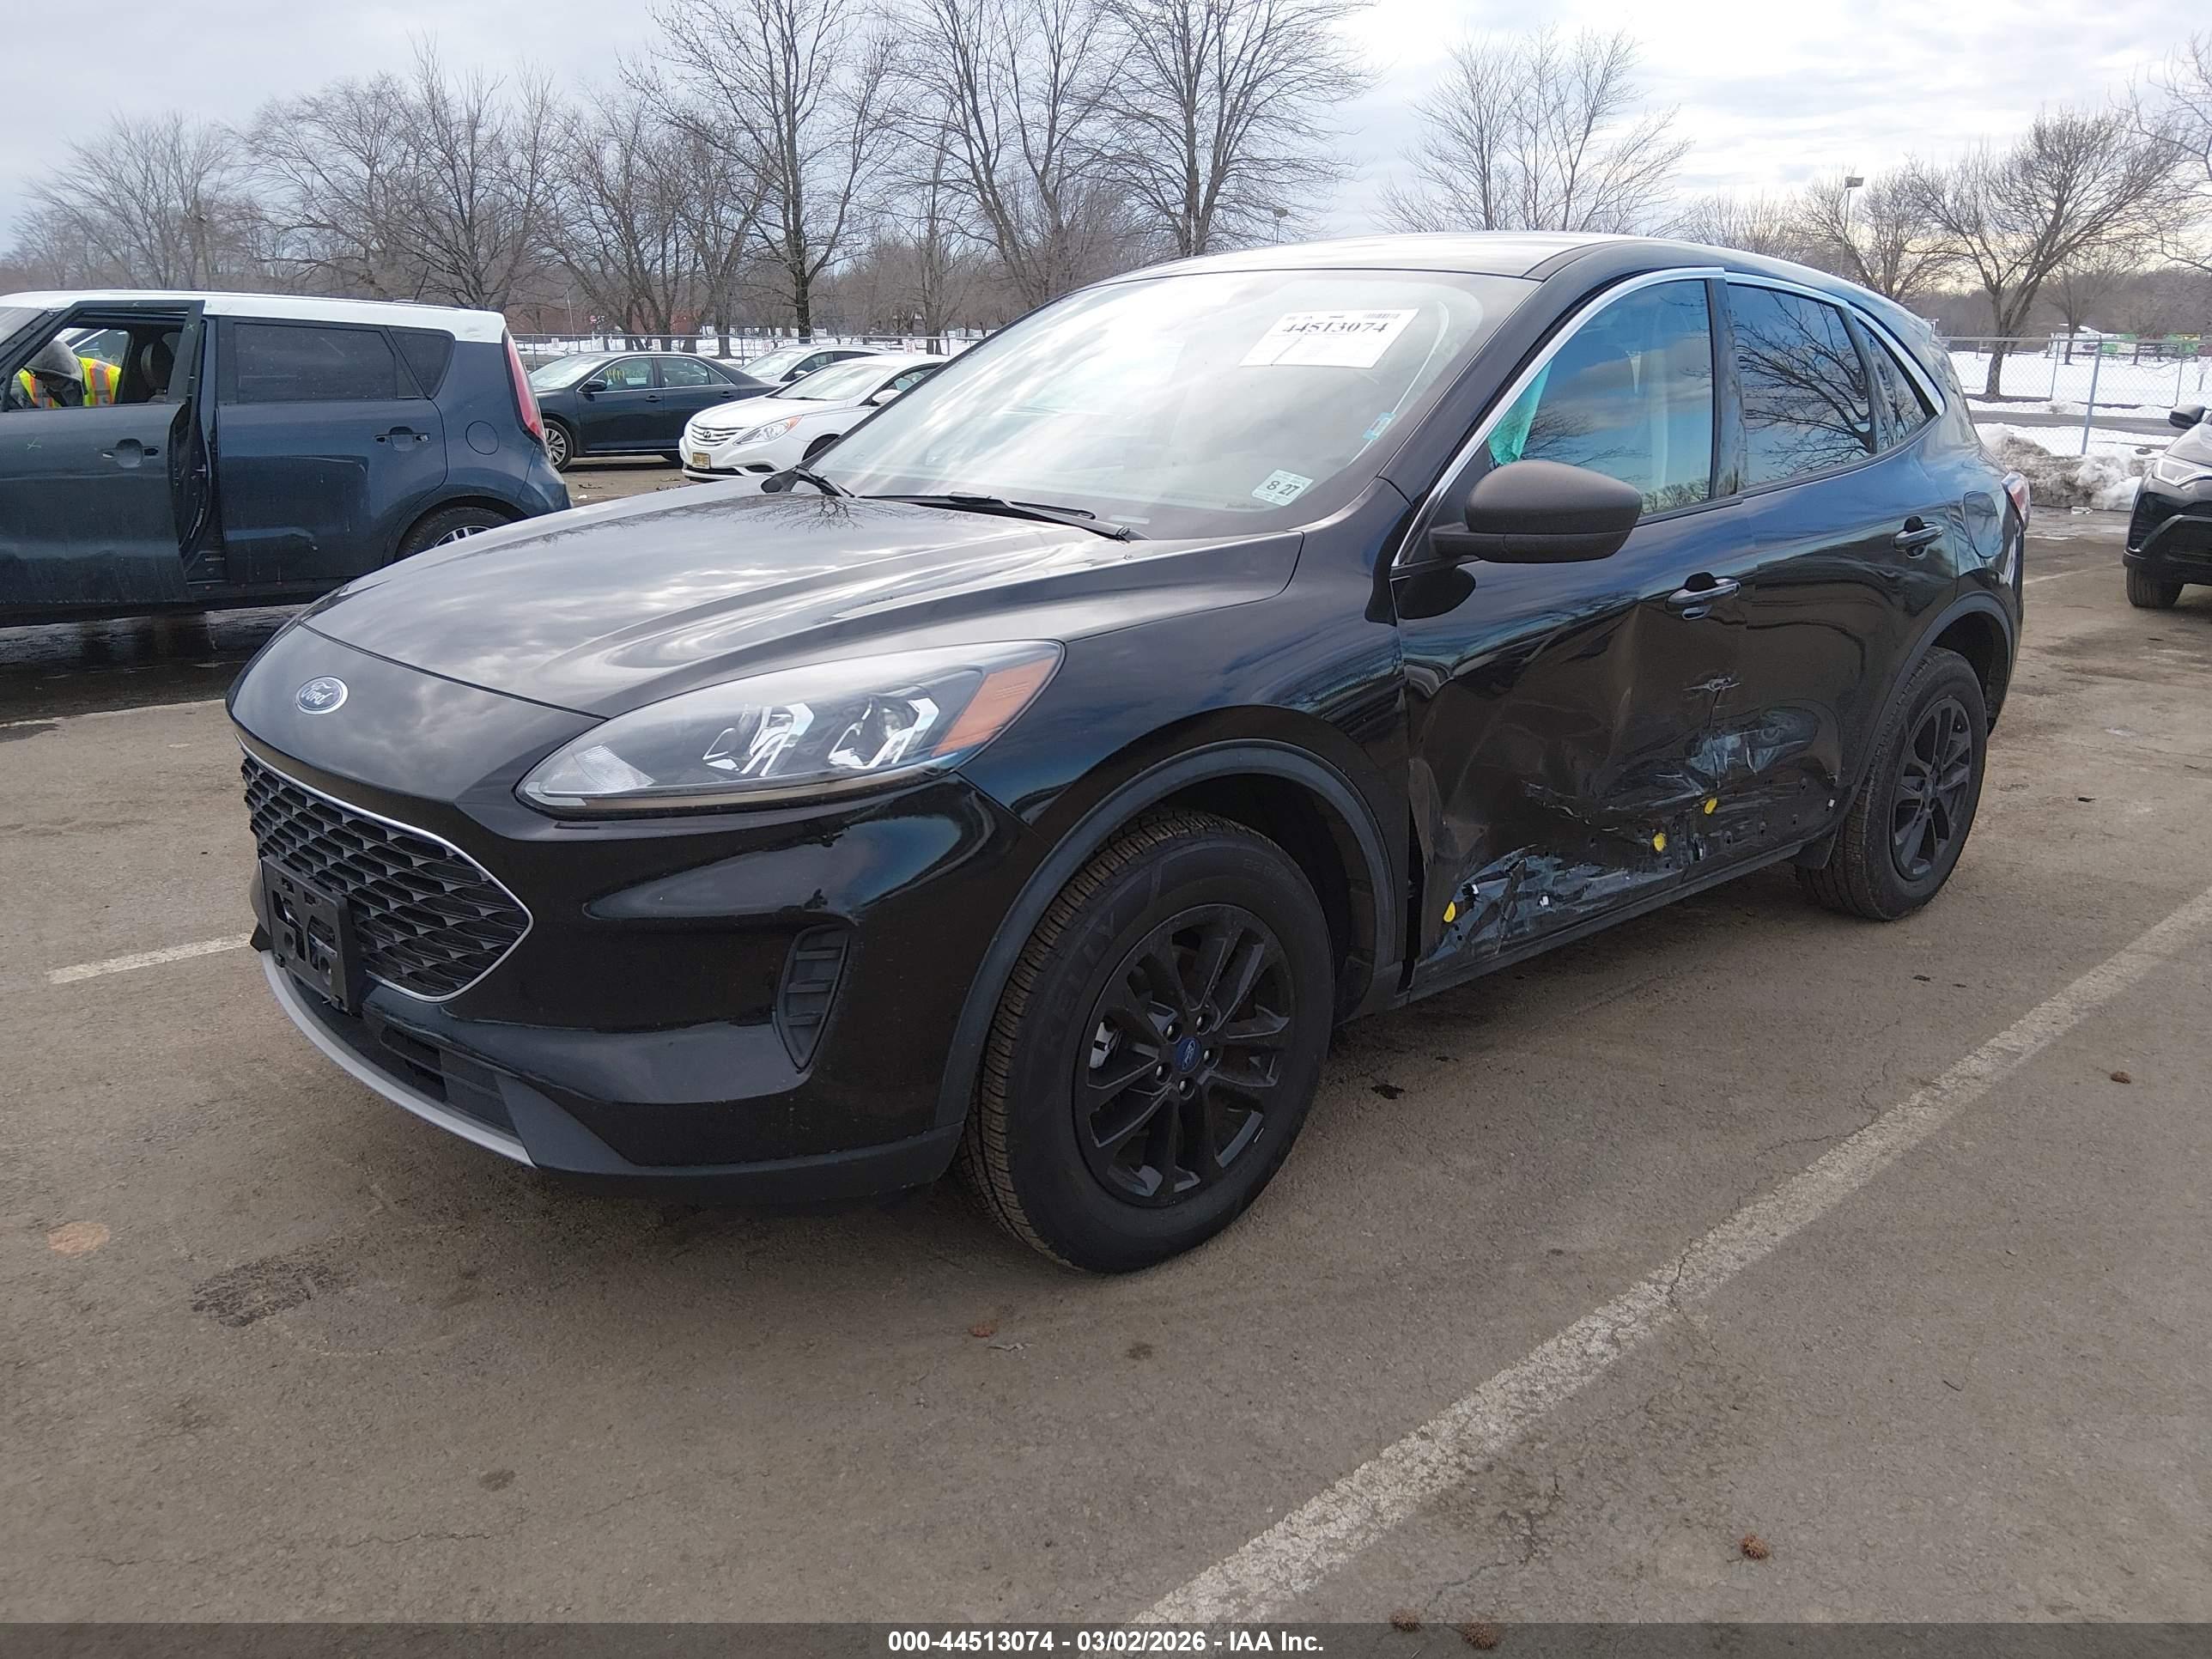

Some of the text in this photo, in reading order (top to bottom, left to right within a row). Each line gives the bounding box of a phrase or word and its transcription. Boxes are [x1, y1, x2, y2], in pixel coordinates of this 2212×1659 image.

[1282, 321, 1389, 333] 44513074
[1266, 480, 1301, 496] 8 27
